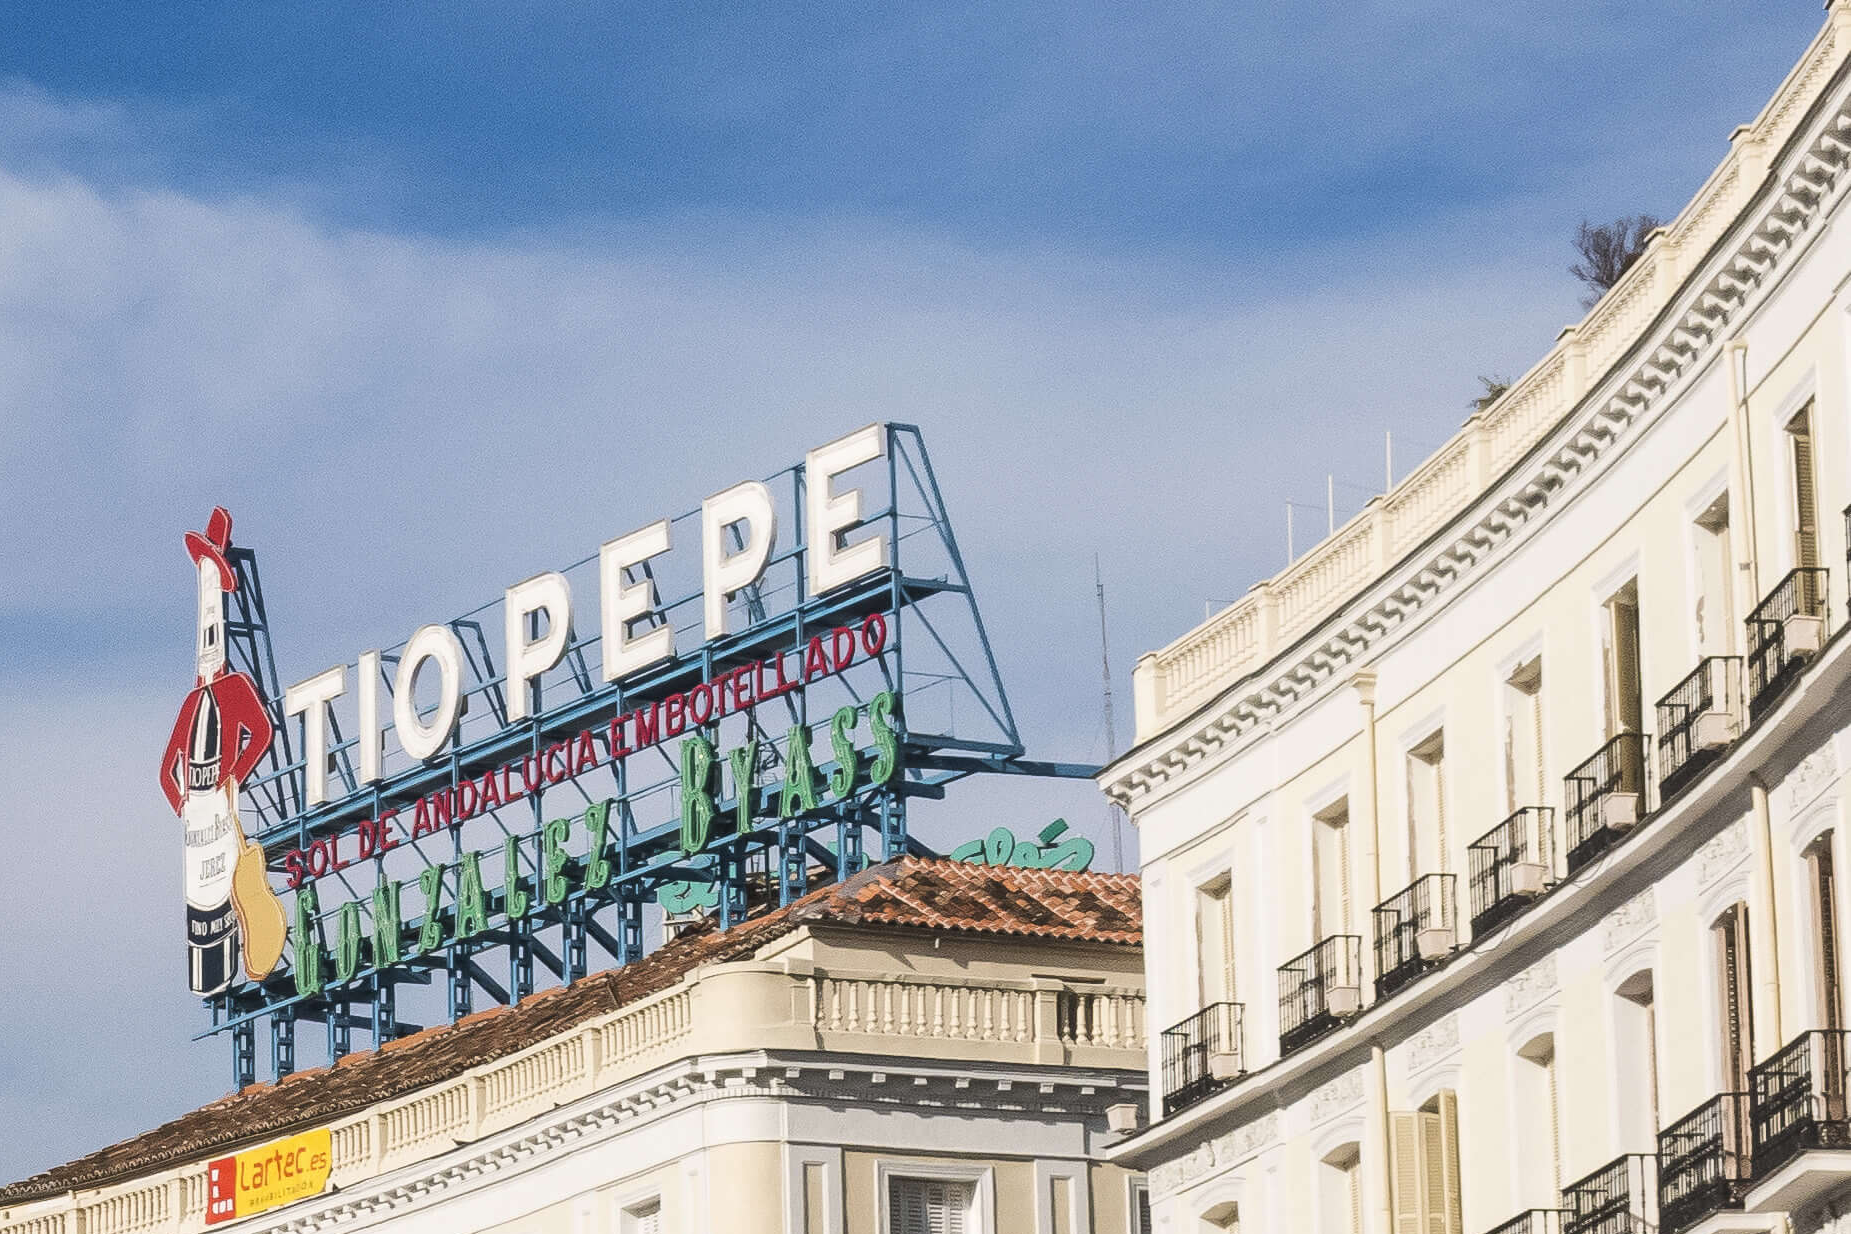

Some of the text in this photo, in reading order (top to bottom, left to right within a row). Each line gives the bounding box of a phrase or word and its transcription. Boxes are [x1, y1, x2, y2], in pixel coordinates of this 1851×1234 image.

[284, 612, 888, 889] SOL DE ANDALUCIA EMBOTELLADO
[285, 421, 890, 806] TIO PEPE
[199, 852, 226, 881] JEREZ
[293, 689, 898, 998] GONZALEZ BYASS
